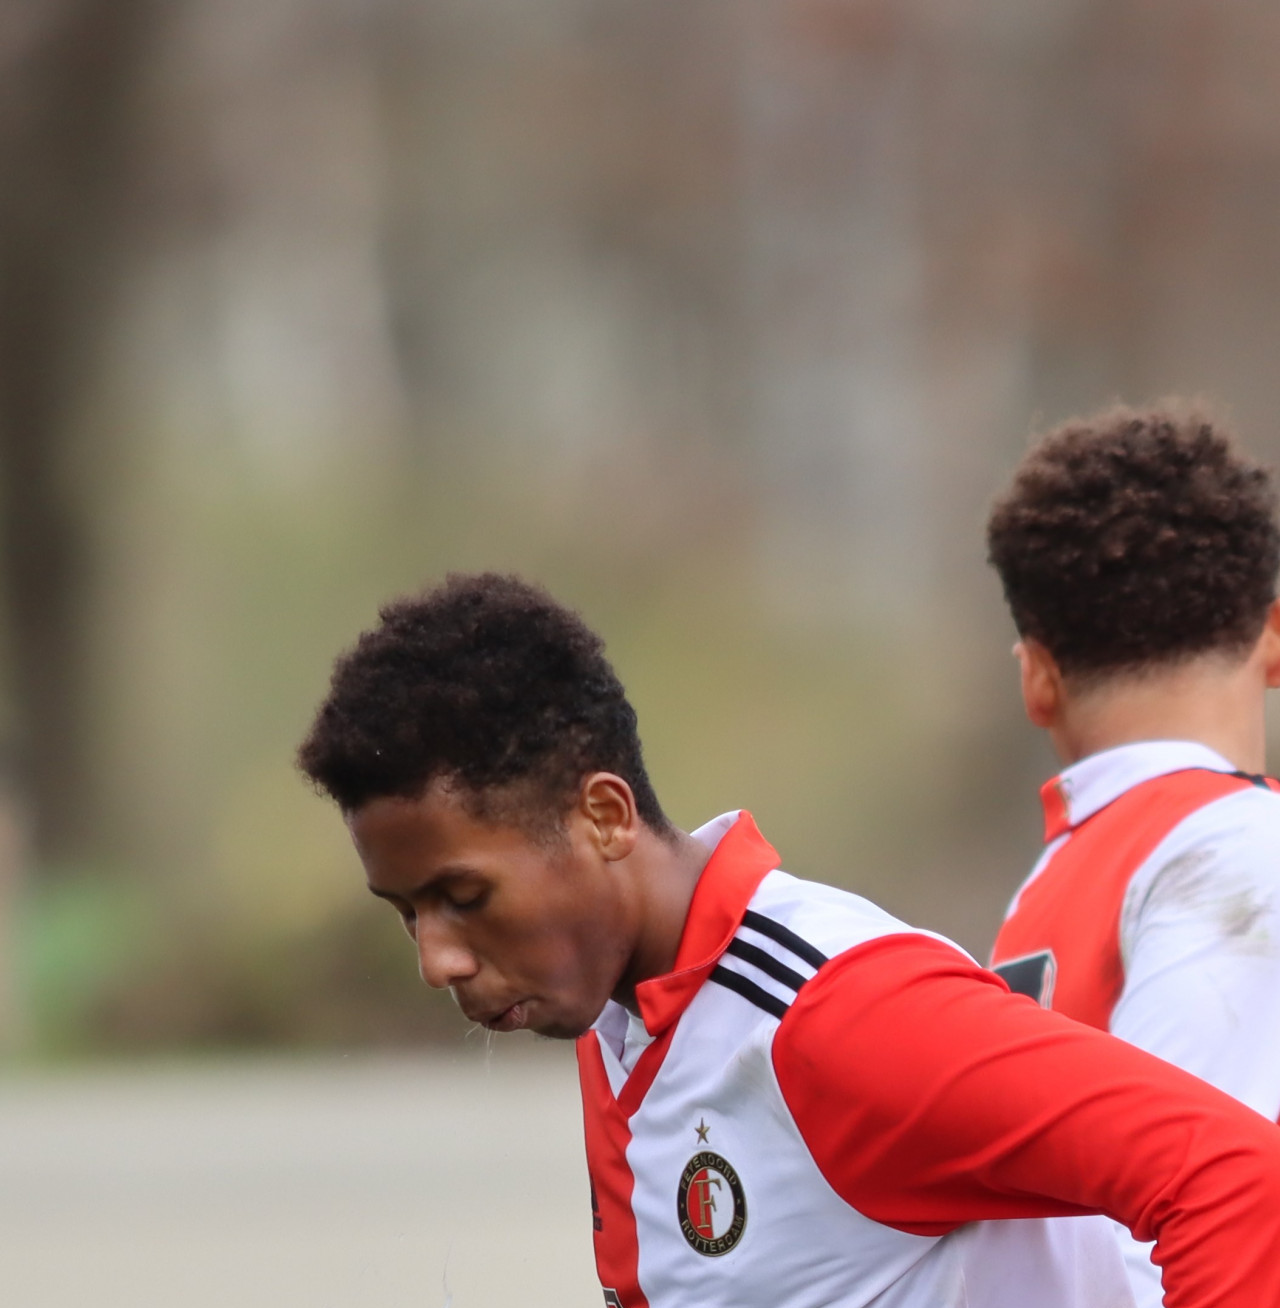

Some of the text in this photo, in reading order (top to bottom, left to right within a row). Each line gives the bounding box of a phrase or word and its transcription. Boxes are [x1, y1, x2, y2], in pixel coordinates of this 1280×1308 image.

[681, 1154, 738, 1191] FEYENOORD
[694, 1178, 722, 1229] F
[682, 1214, 744, 1253] ROTTERDAM
